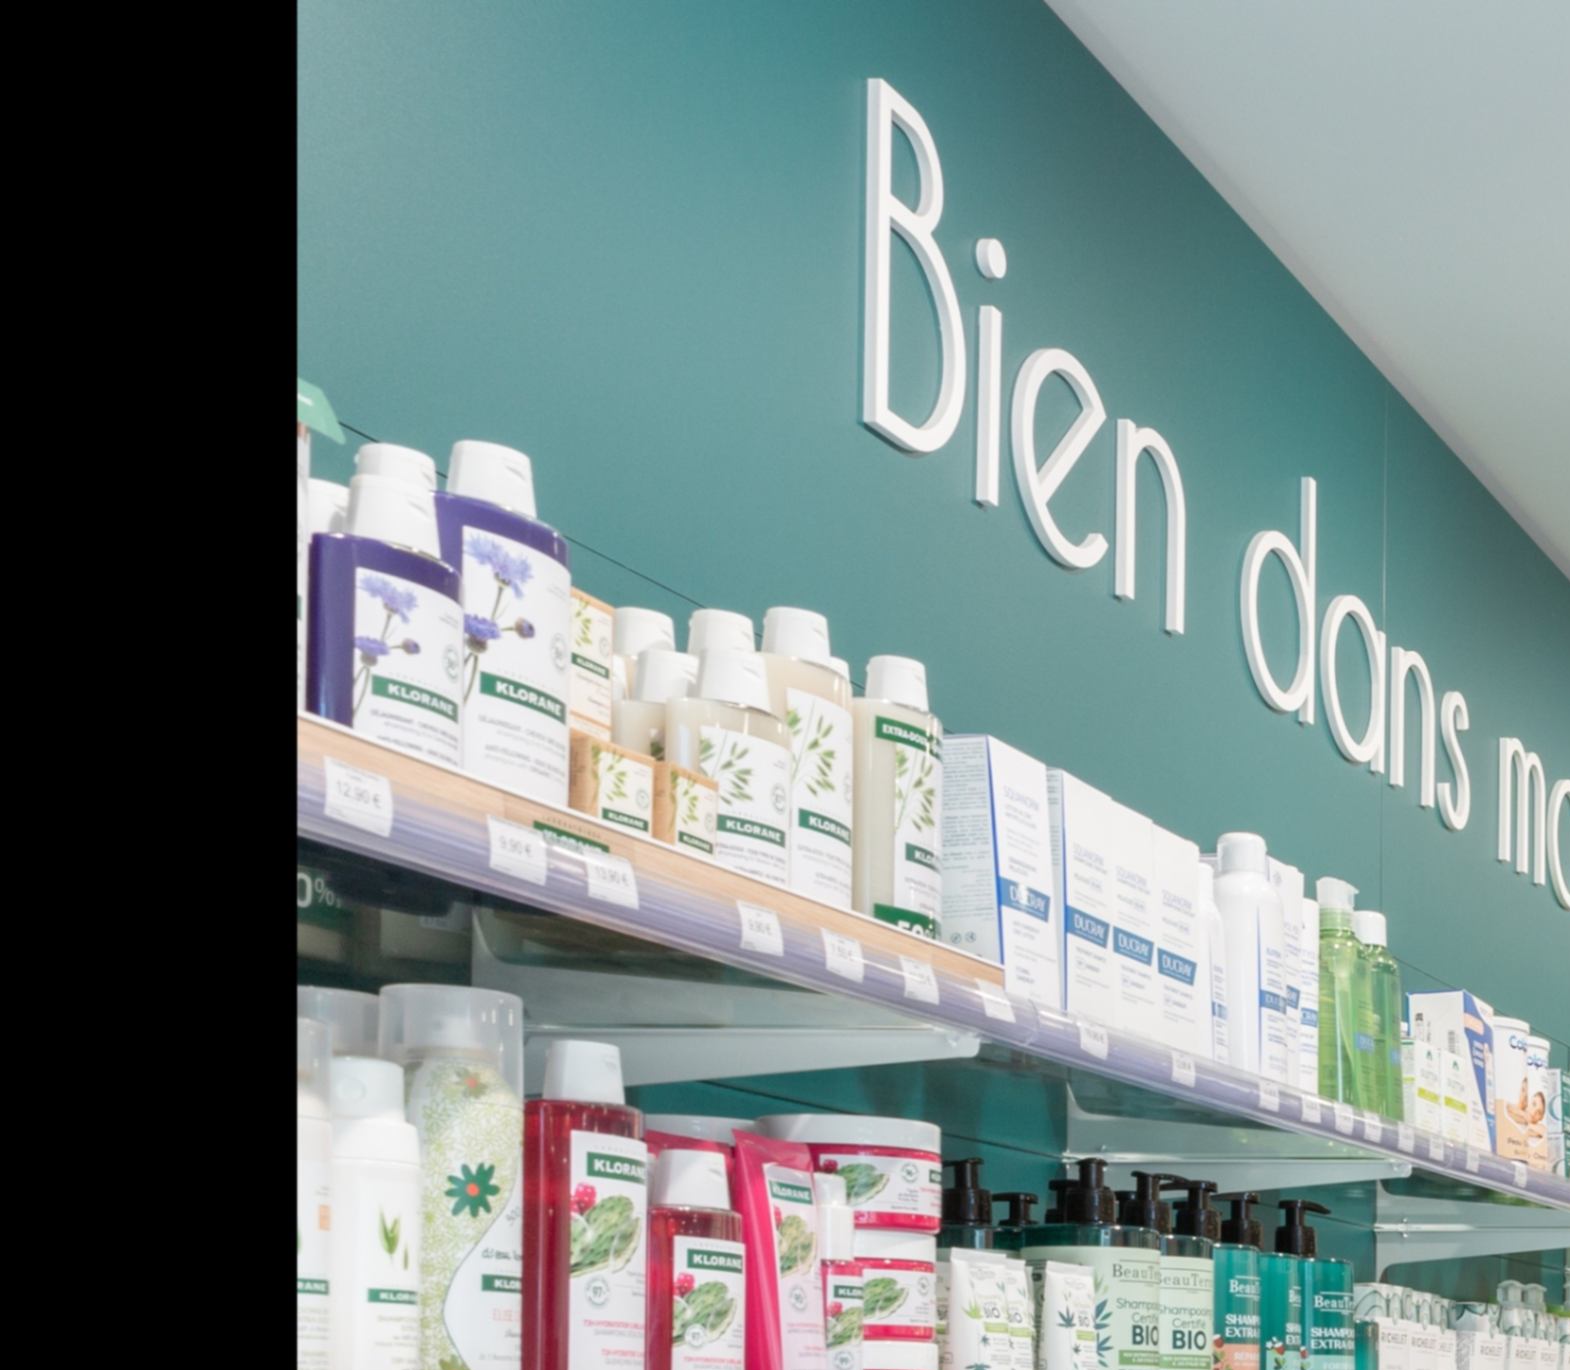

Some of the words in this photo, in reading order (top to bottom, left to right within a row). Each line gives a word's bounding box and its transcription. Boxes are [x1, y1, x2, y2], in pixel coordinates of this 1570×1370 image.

[863, 78, 1187, 635] Bien
[1240, 477, 1470, 832] dans
[388, 683, 454, 715] KLORANE
[495, 681, 562, 717] KLORANE
[725, 818, 782, 843] KLORANE
[1171, 1330, 1207, 1351] BIO
